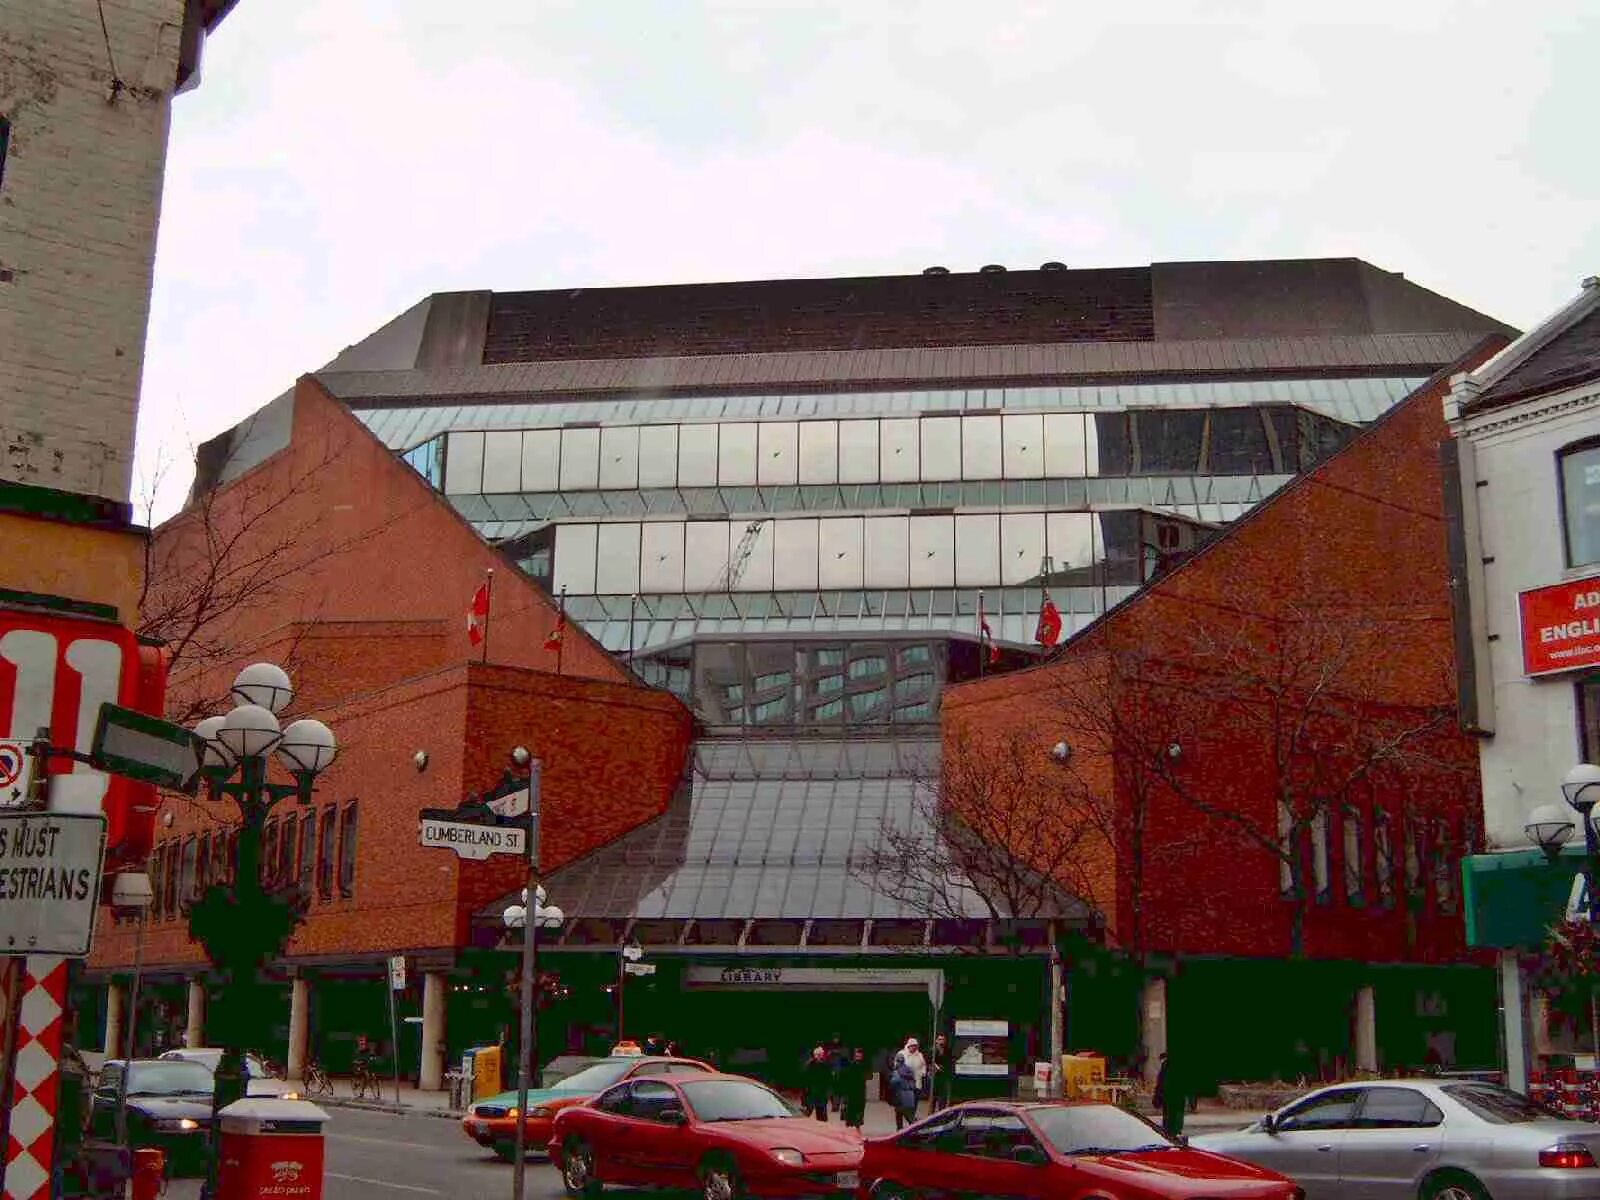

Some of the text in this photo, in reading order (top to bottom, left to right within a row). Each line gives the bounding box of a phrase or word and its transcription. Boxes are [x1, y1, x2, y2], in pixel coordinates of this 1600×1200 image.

[12, 827, 61, 858] MUST
[426, 827, 502, 846] CUMBERLAND
[720, 971, 781, 983] LIBRARY
